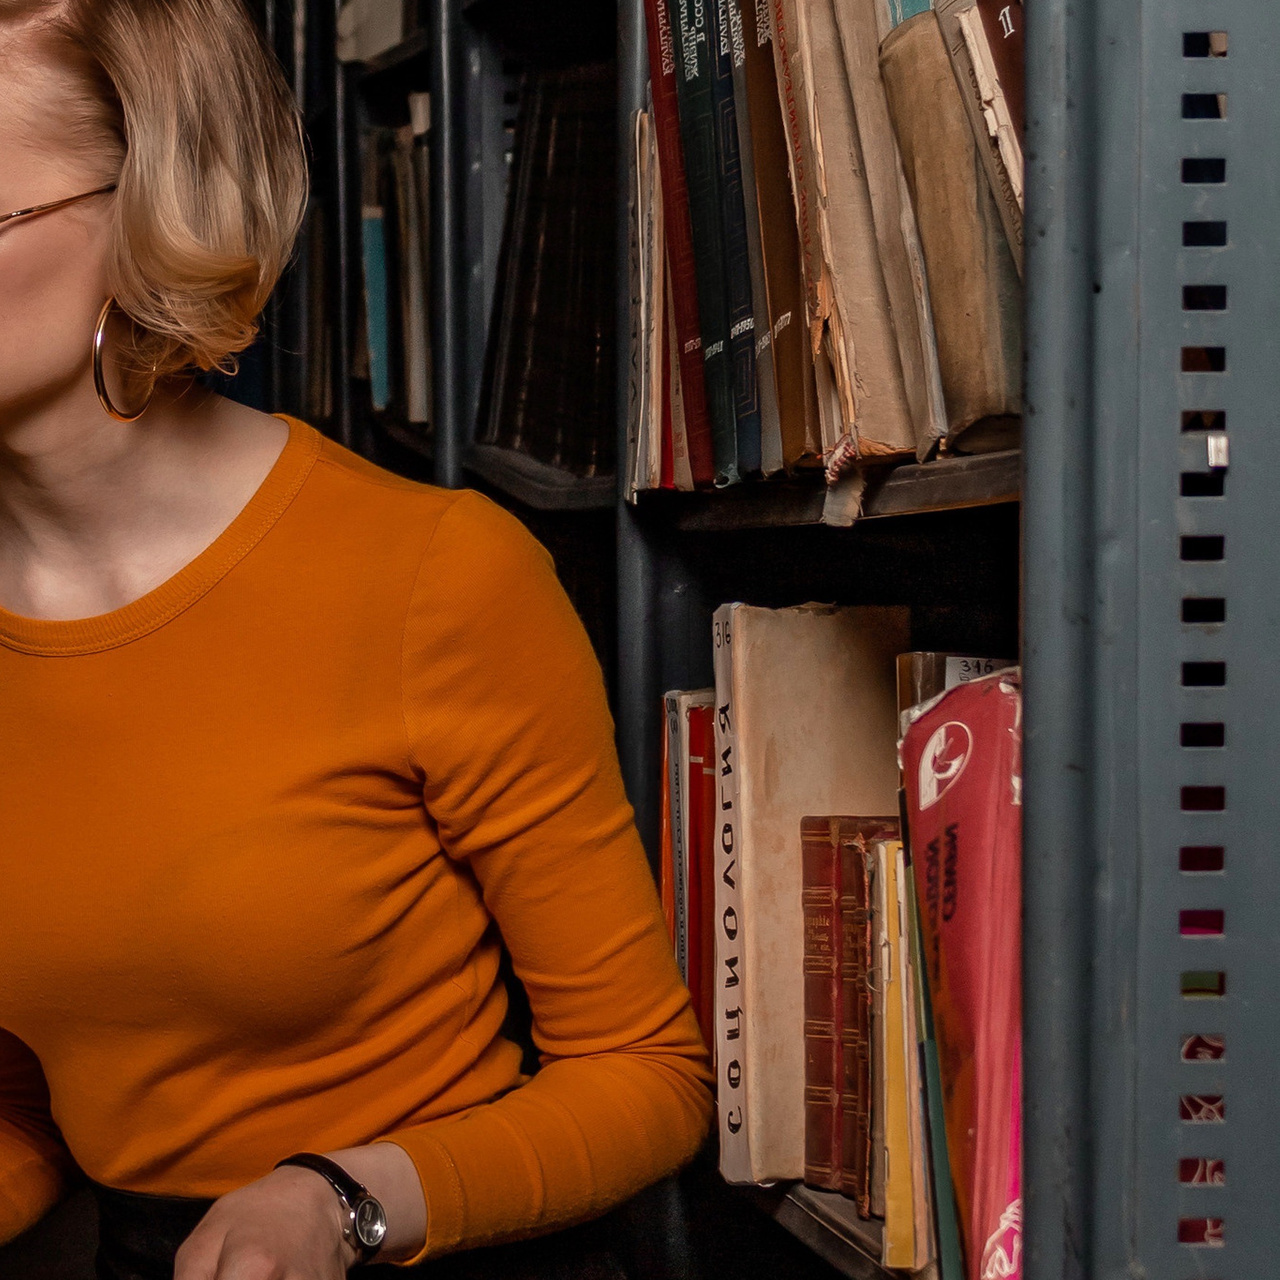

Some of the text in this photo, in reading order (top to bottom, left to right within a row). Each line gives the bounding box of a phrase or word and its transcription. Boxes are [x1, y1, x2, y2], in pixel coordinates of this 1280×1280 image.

[687, 26, 701, 78] ЖИЗНЬ
[695, 32, 706, 43] В
[714, 620, 732, 649] 316
[716, 701, 745, 1135] СОЦИОЛОГИЯ
